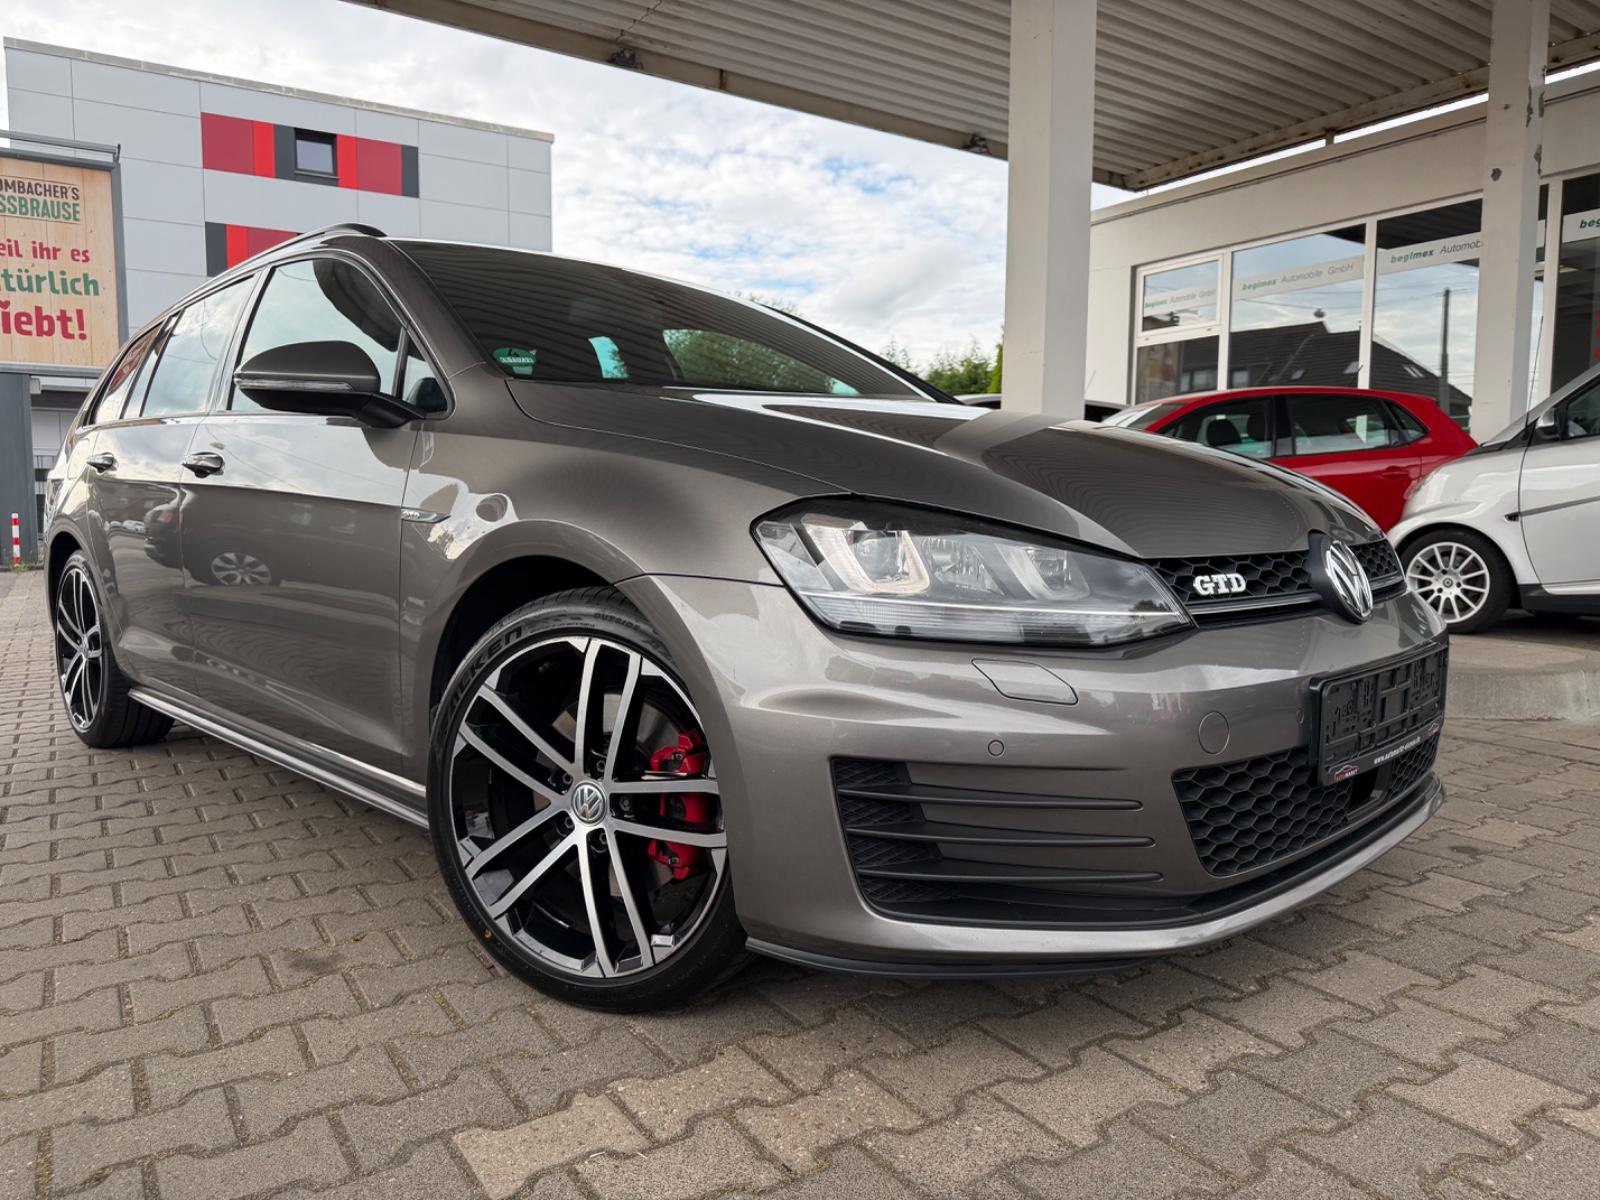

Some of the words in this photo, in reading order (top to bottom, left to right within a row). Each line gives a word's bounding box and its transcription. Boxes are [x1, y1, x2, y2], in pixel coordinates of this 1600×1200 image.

[0, 178, 80, 201] MBACHER'S
[31, 240, 61, 260] ihr
[70, 248, 90, 263] es
[0, 268, 99, 296] türlich
[1193, 572, 1247, 596] GTD
